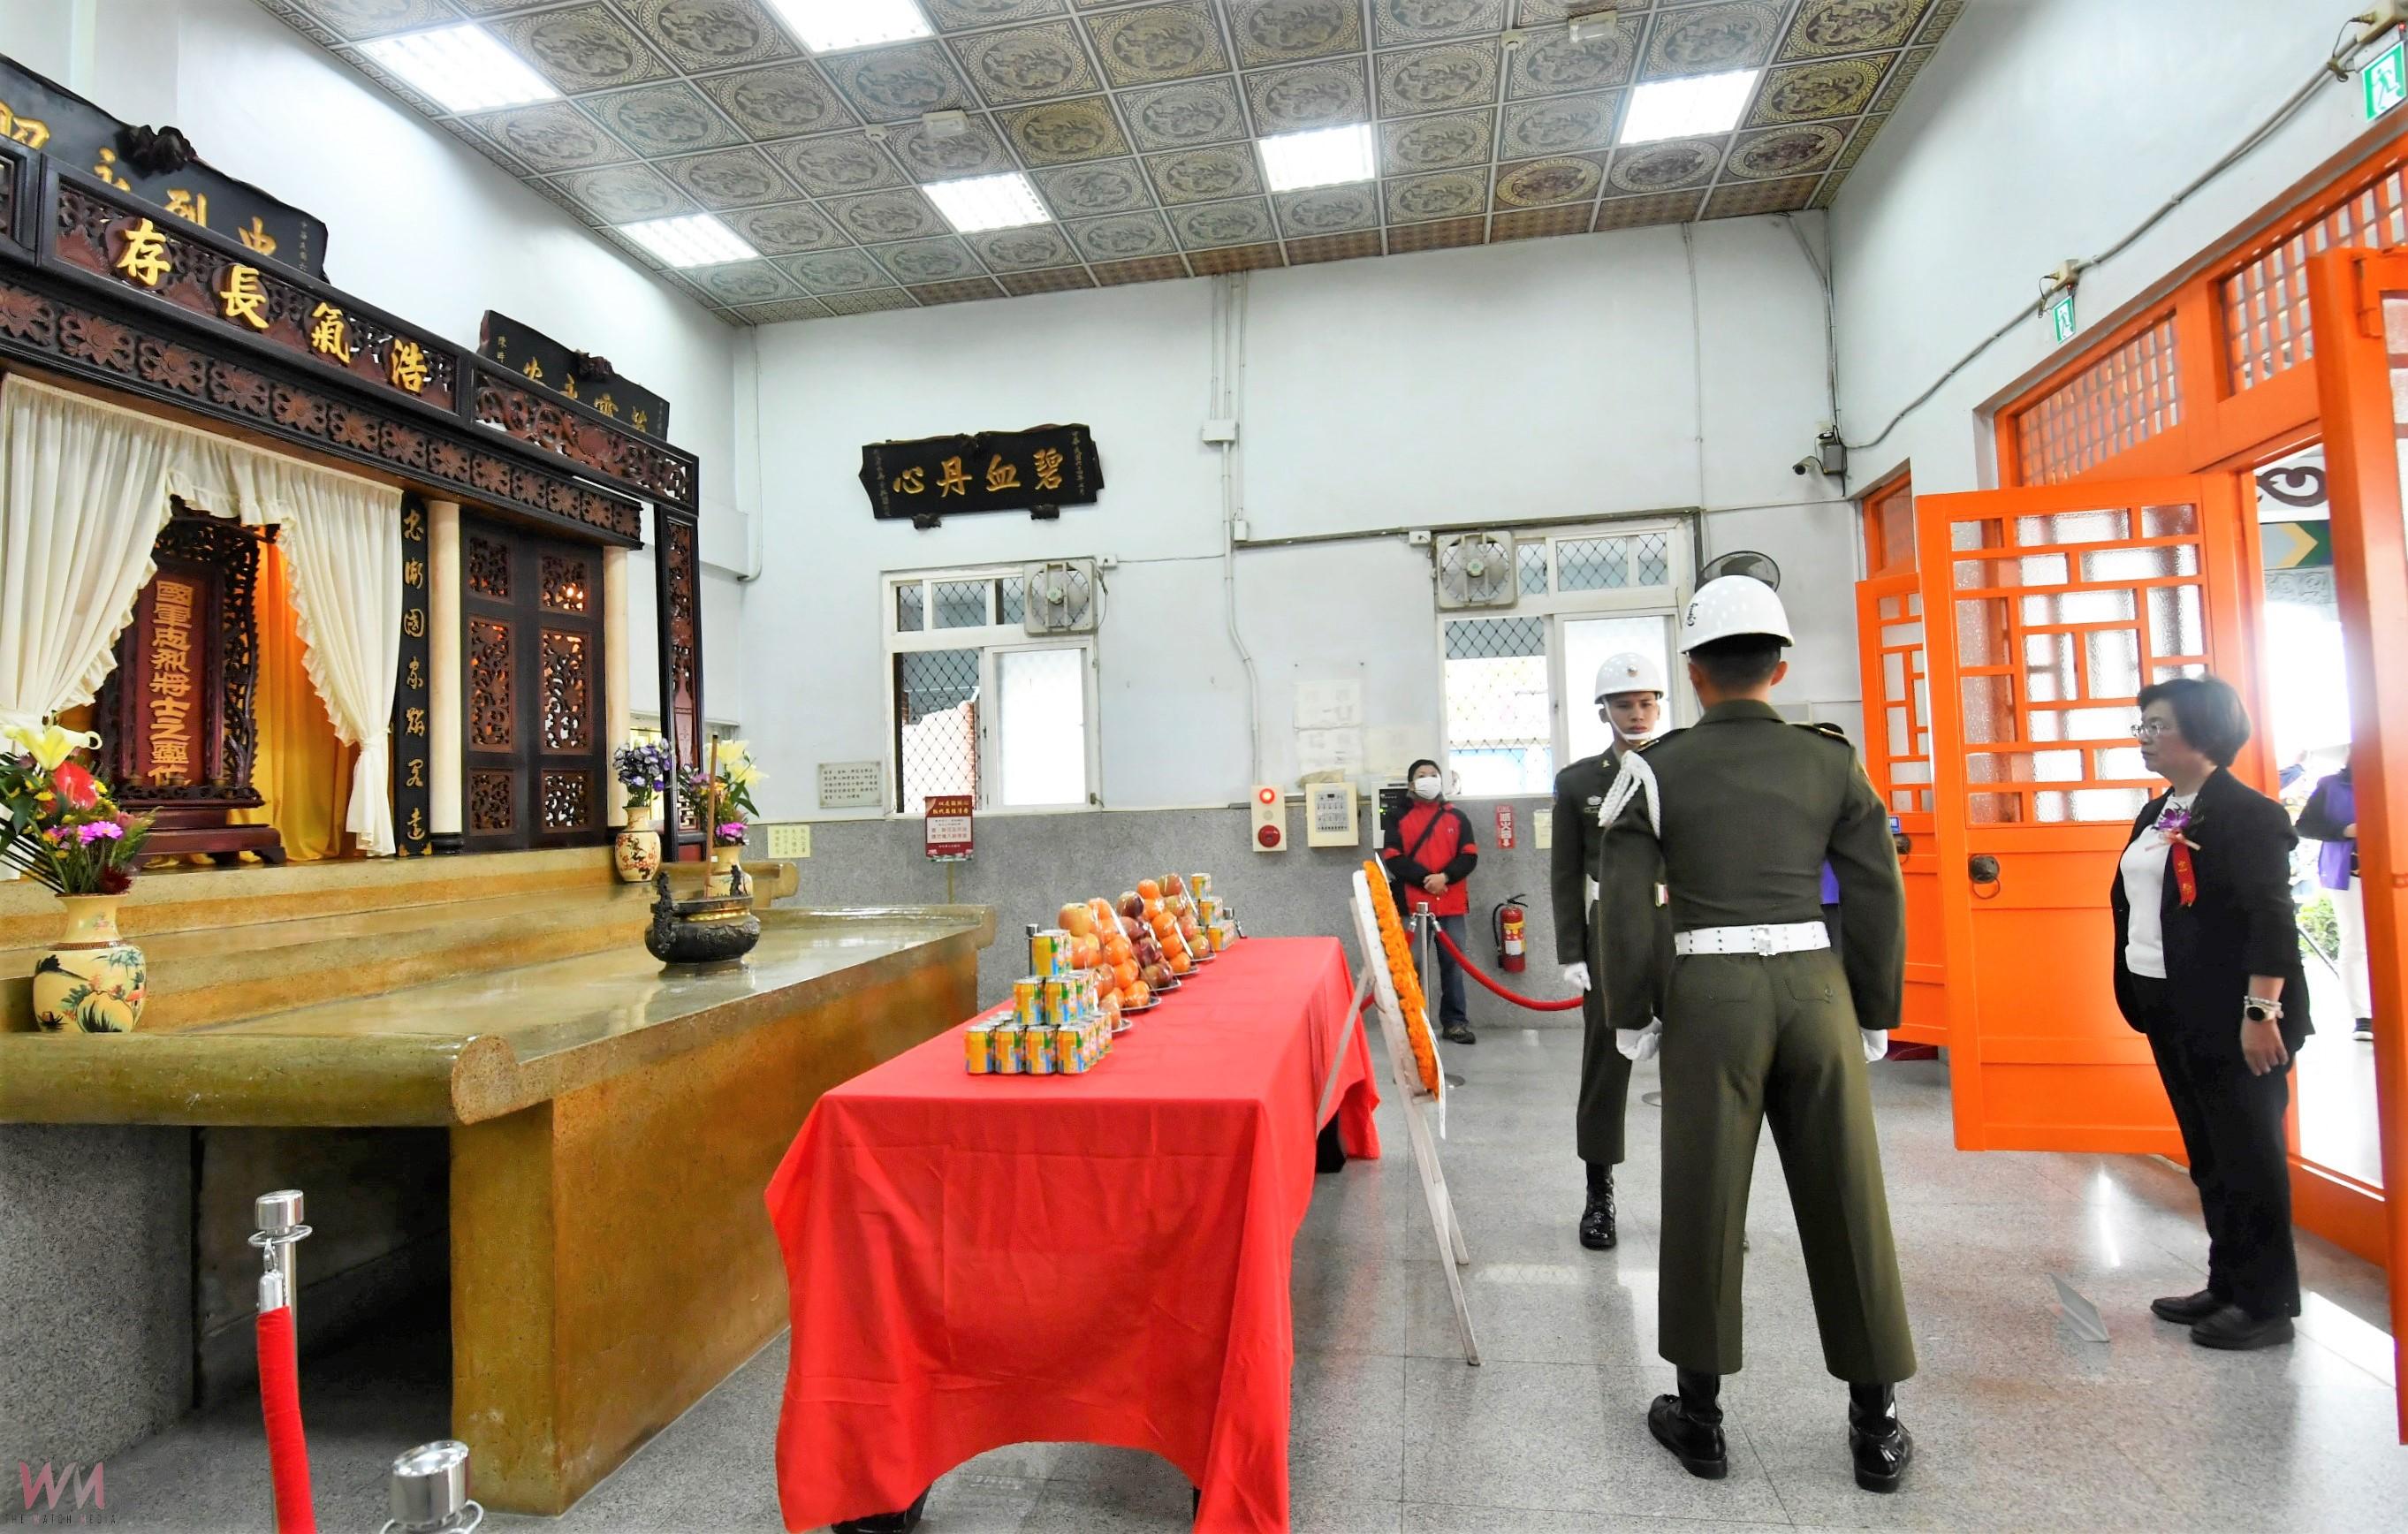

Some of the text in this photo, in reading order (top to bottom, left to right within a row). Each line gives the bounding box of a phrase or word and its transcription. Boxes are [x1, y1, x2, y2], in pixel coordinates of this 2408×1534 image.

[117, 217, 428, 395] 浩氣長存
[893, 446, 1063, 497] 碧血丹心
